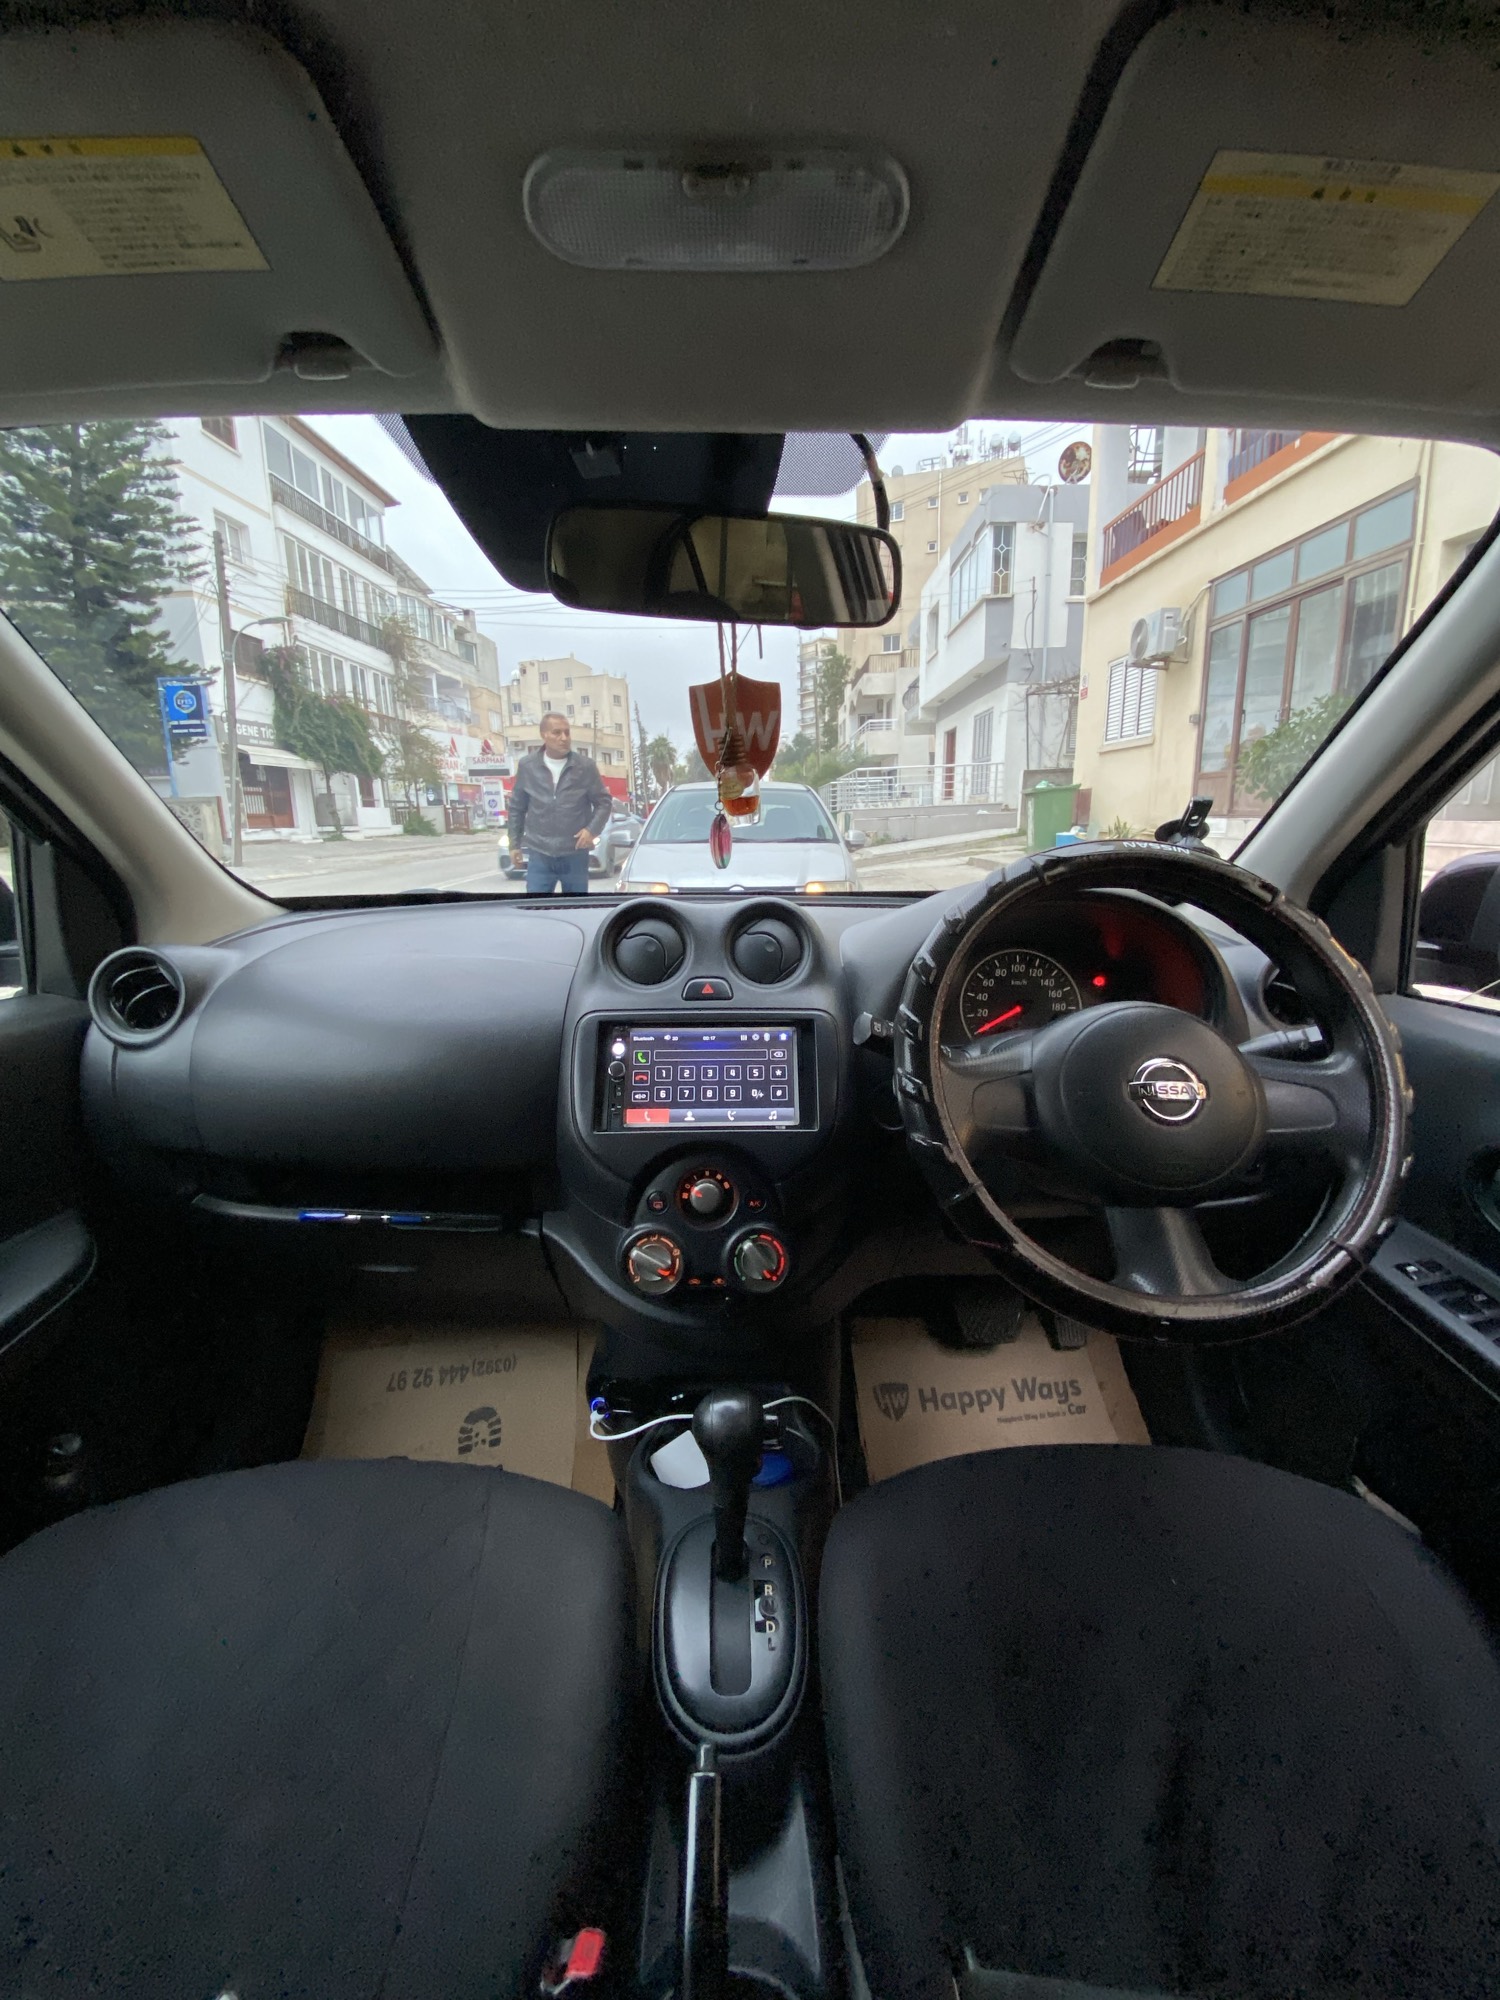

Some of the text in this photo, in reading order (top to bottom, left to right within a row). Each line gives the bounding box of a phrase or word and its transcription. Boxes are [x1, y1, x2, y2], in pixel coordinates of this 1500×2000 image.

[223, 722, 259, 737] EGENE
[472, 756, 505, 765] SARPHAN
[1122, 841, 1190, 855] NISSAN
[995, 968, 1007, 976] 80
[1011, 964, 1025, 972] 100
[1029, 968, 1043, 976] 120
[982, 979, 994, 987] 60
[1040, 979, 1055, 987] 140
[977, 993, 988, 1001] 40
[1048, 990, 1062, 998] 160
[1052, 1003, 1066, 1011] 180
[977, 1008, 988, 1017] 20
[661, 1068, 759, 1078] 1 2 3 4 5
[660, 1090, 666, 1098] 6
[683, 1090, 690, 1098] 7
[706, 1089, 713, 1098] 8
[730, 1089, 736, 1097] 9
[1138, 1085, 1203, 1097] NISSAN
[386, 1370, 408, 1392] 97
[412, 1367, 434, 1389] 92
[918, 1377, 1082, 1415] Happy Ways
[1068, 1403, 1086, 1415] Car
[764, 1559, 772, 1569] P
[764, 1584, 773, 1596] R
[765, 1620, 776, 1633] D
[767, 1637, 776, 1652] L
